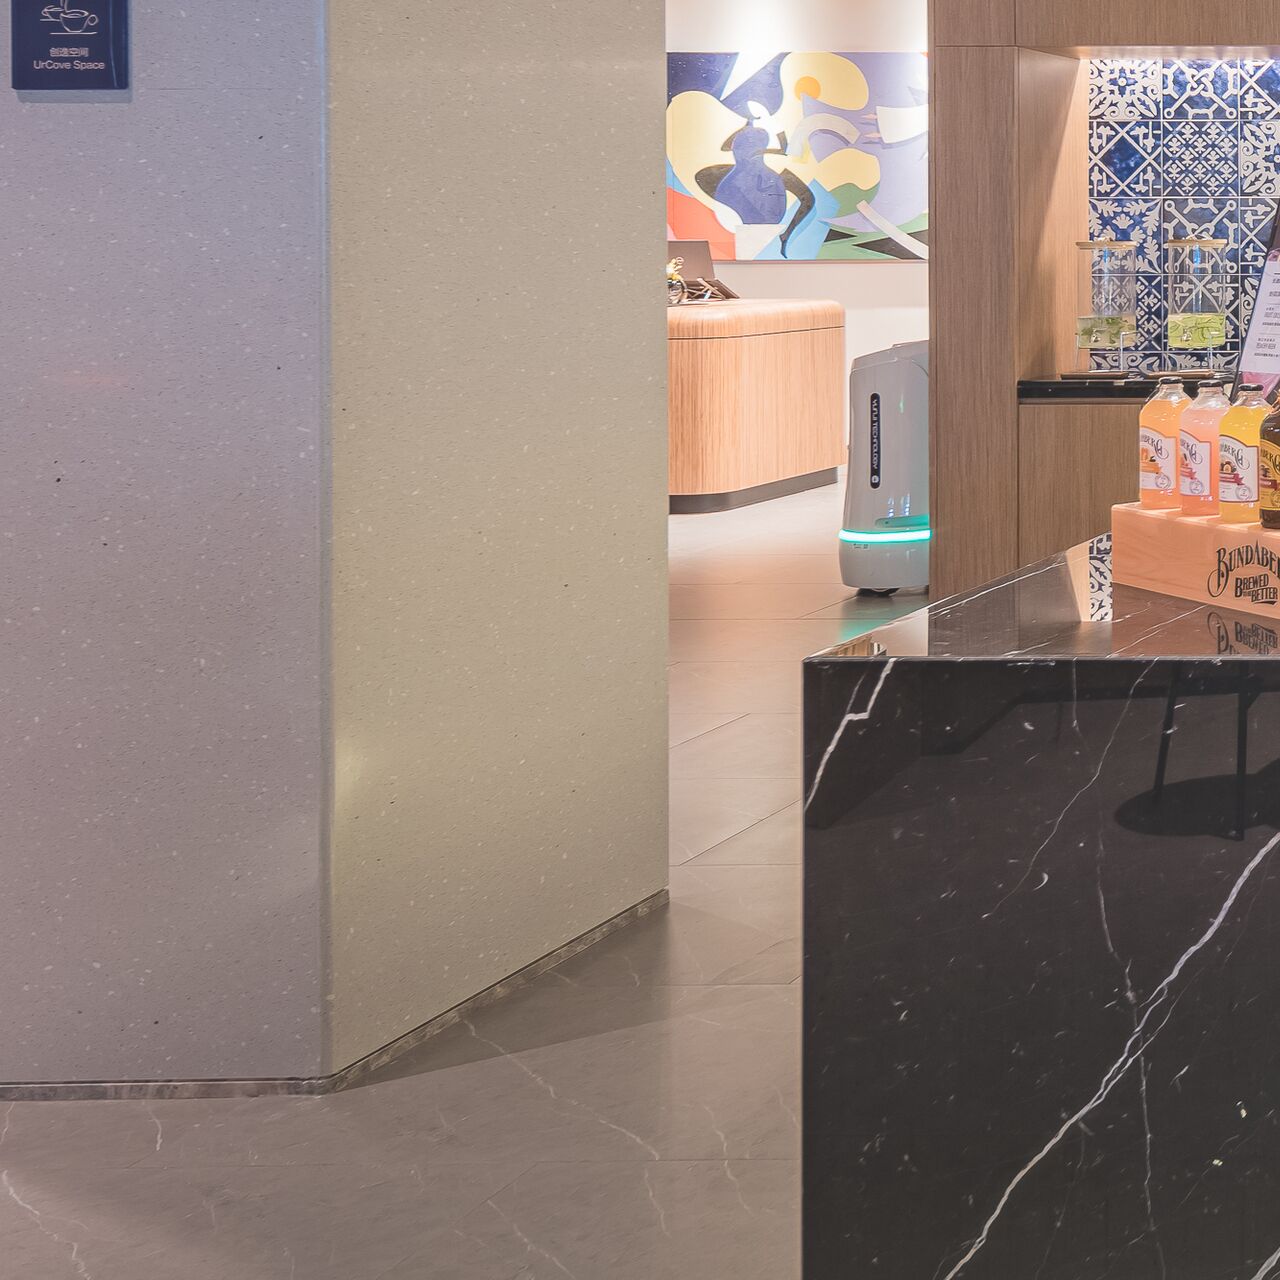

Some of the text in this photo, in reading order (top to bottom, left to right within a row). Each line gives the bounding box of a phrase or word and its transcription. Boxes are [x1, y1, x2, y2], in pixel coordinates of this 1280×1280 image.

[33, 60, 105, 71] UrCove Space
[1235, 573, 1270, 598] BREWED
[1251, 587, 1279, 603] BETTER
